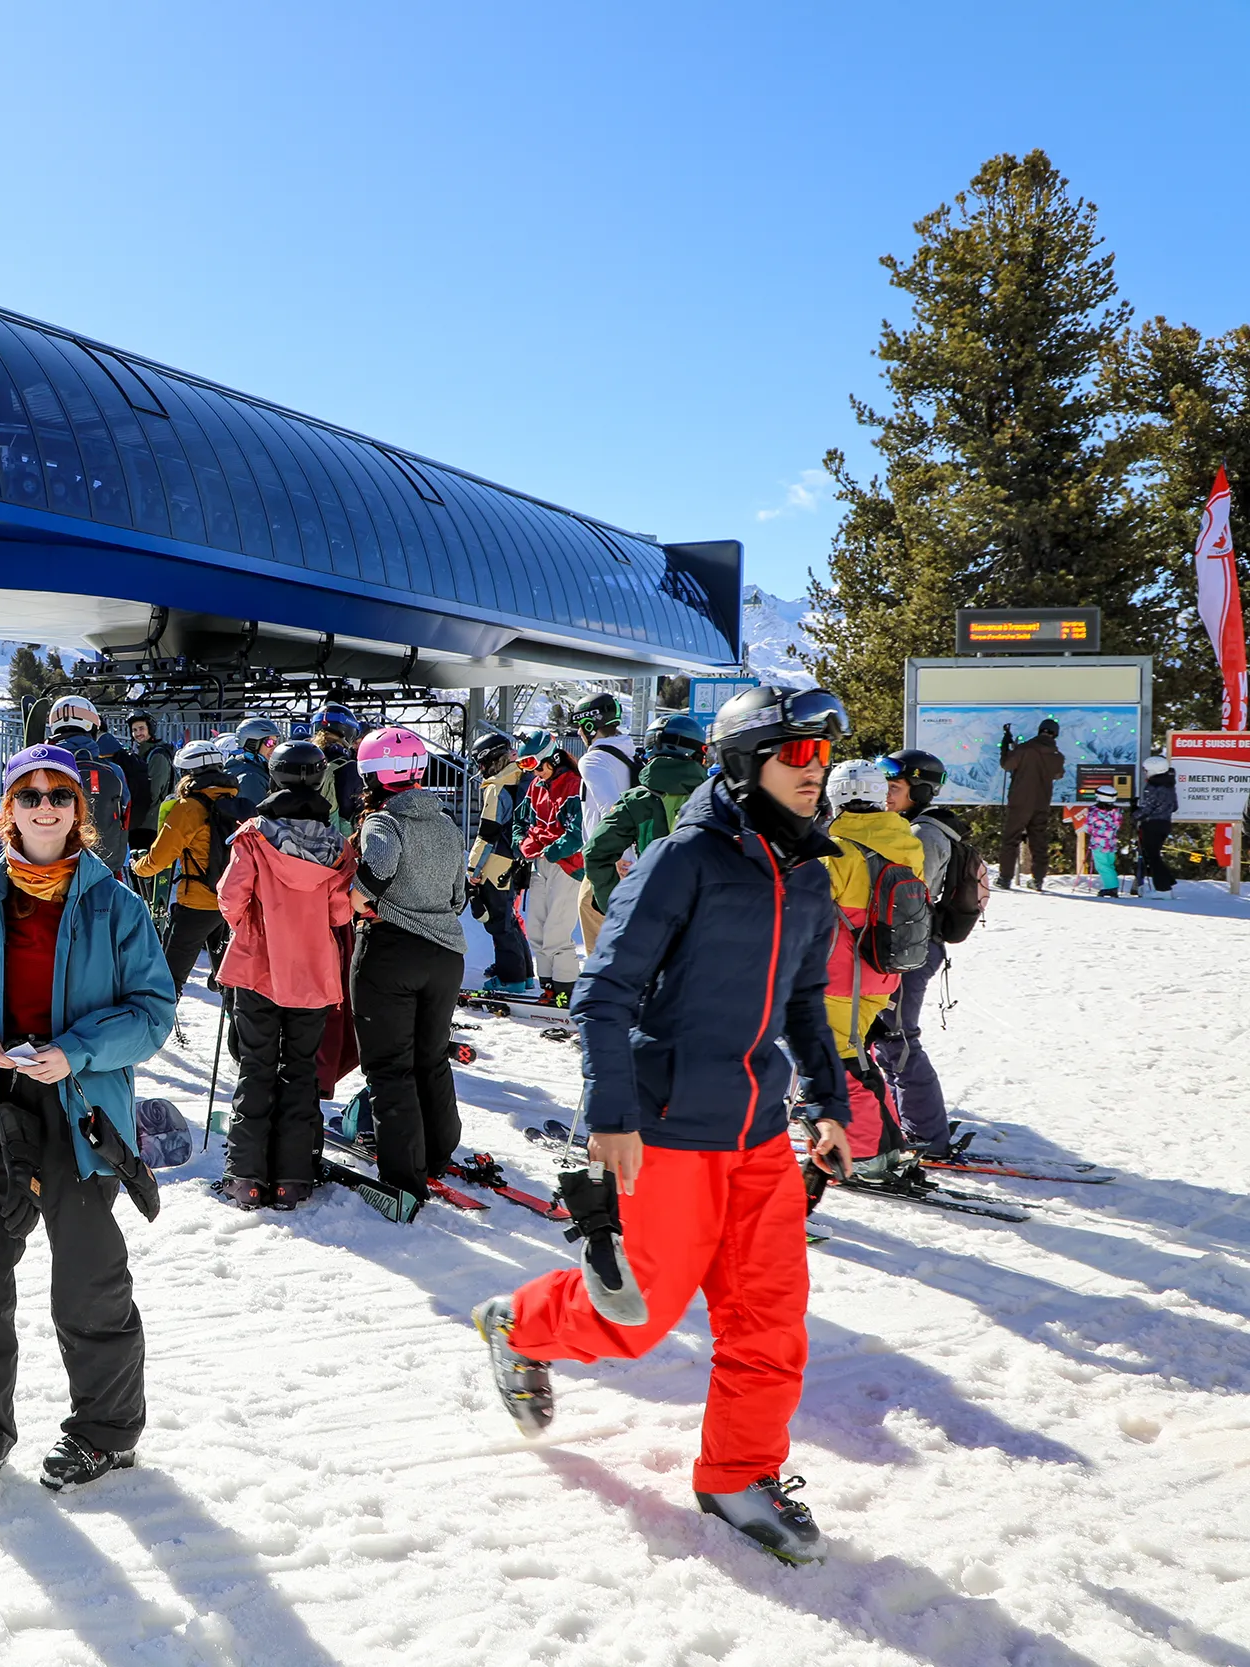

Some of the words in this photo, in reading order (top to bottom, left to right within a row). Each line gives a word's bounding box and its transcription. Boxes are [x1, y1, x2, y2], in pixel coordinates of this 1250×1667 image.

[572, 709, 600, 721] GIRO
[1176, 738, 1203, 748] ÉCOLE
[1205, 739, 1236, 748] SUISSE
[1188, 775, 1225, 783] MEETING
